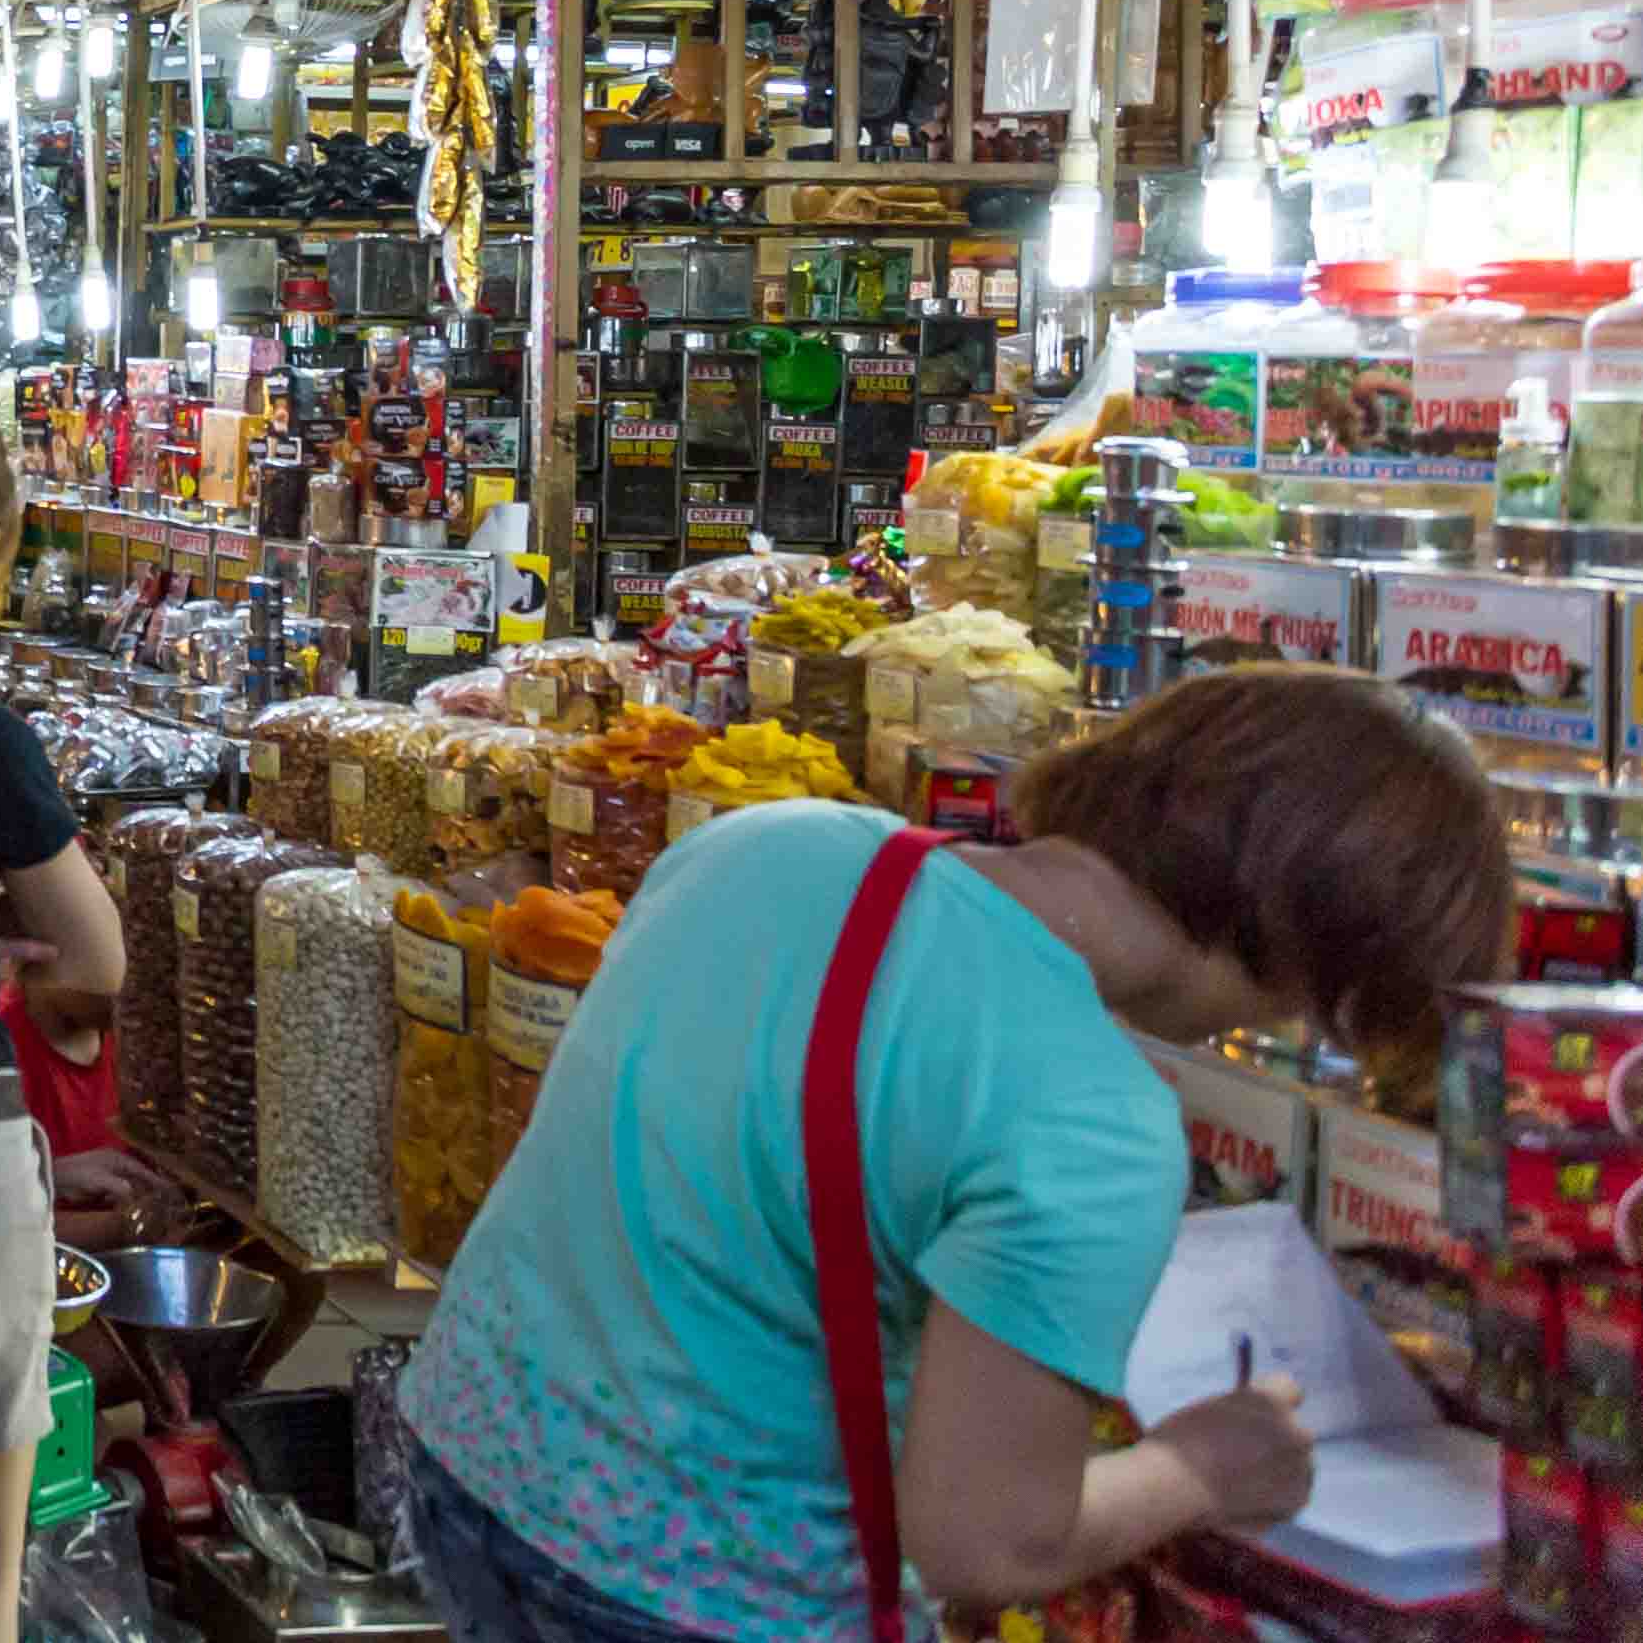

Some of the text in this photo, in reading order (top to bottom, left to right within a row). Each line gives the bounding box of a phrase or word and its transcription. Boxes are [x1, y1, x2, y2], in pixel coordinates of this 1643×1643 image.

[625, 139, 702, 151] open VISA
[852, 360, 913, 374] COFFEE
[616, 423, 675, 438] COFFEE
[775, 427, 834, 441] COFFEE
[924, 427, 986, 442] COFFEE
[690, 510, 747, 523] COFFEE
[1405, 627, 1569, 677] ARABICA
